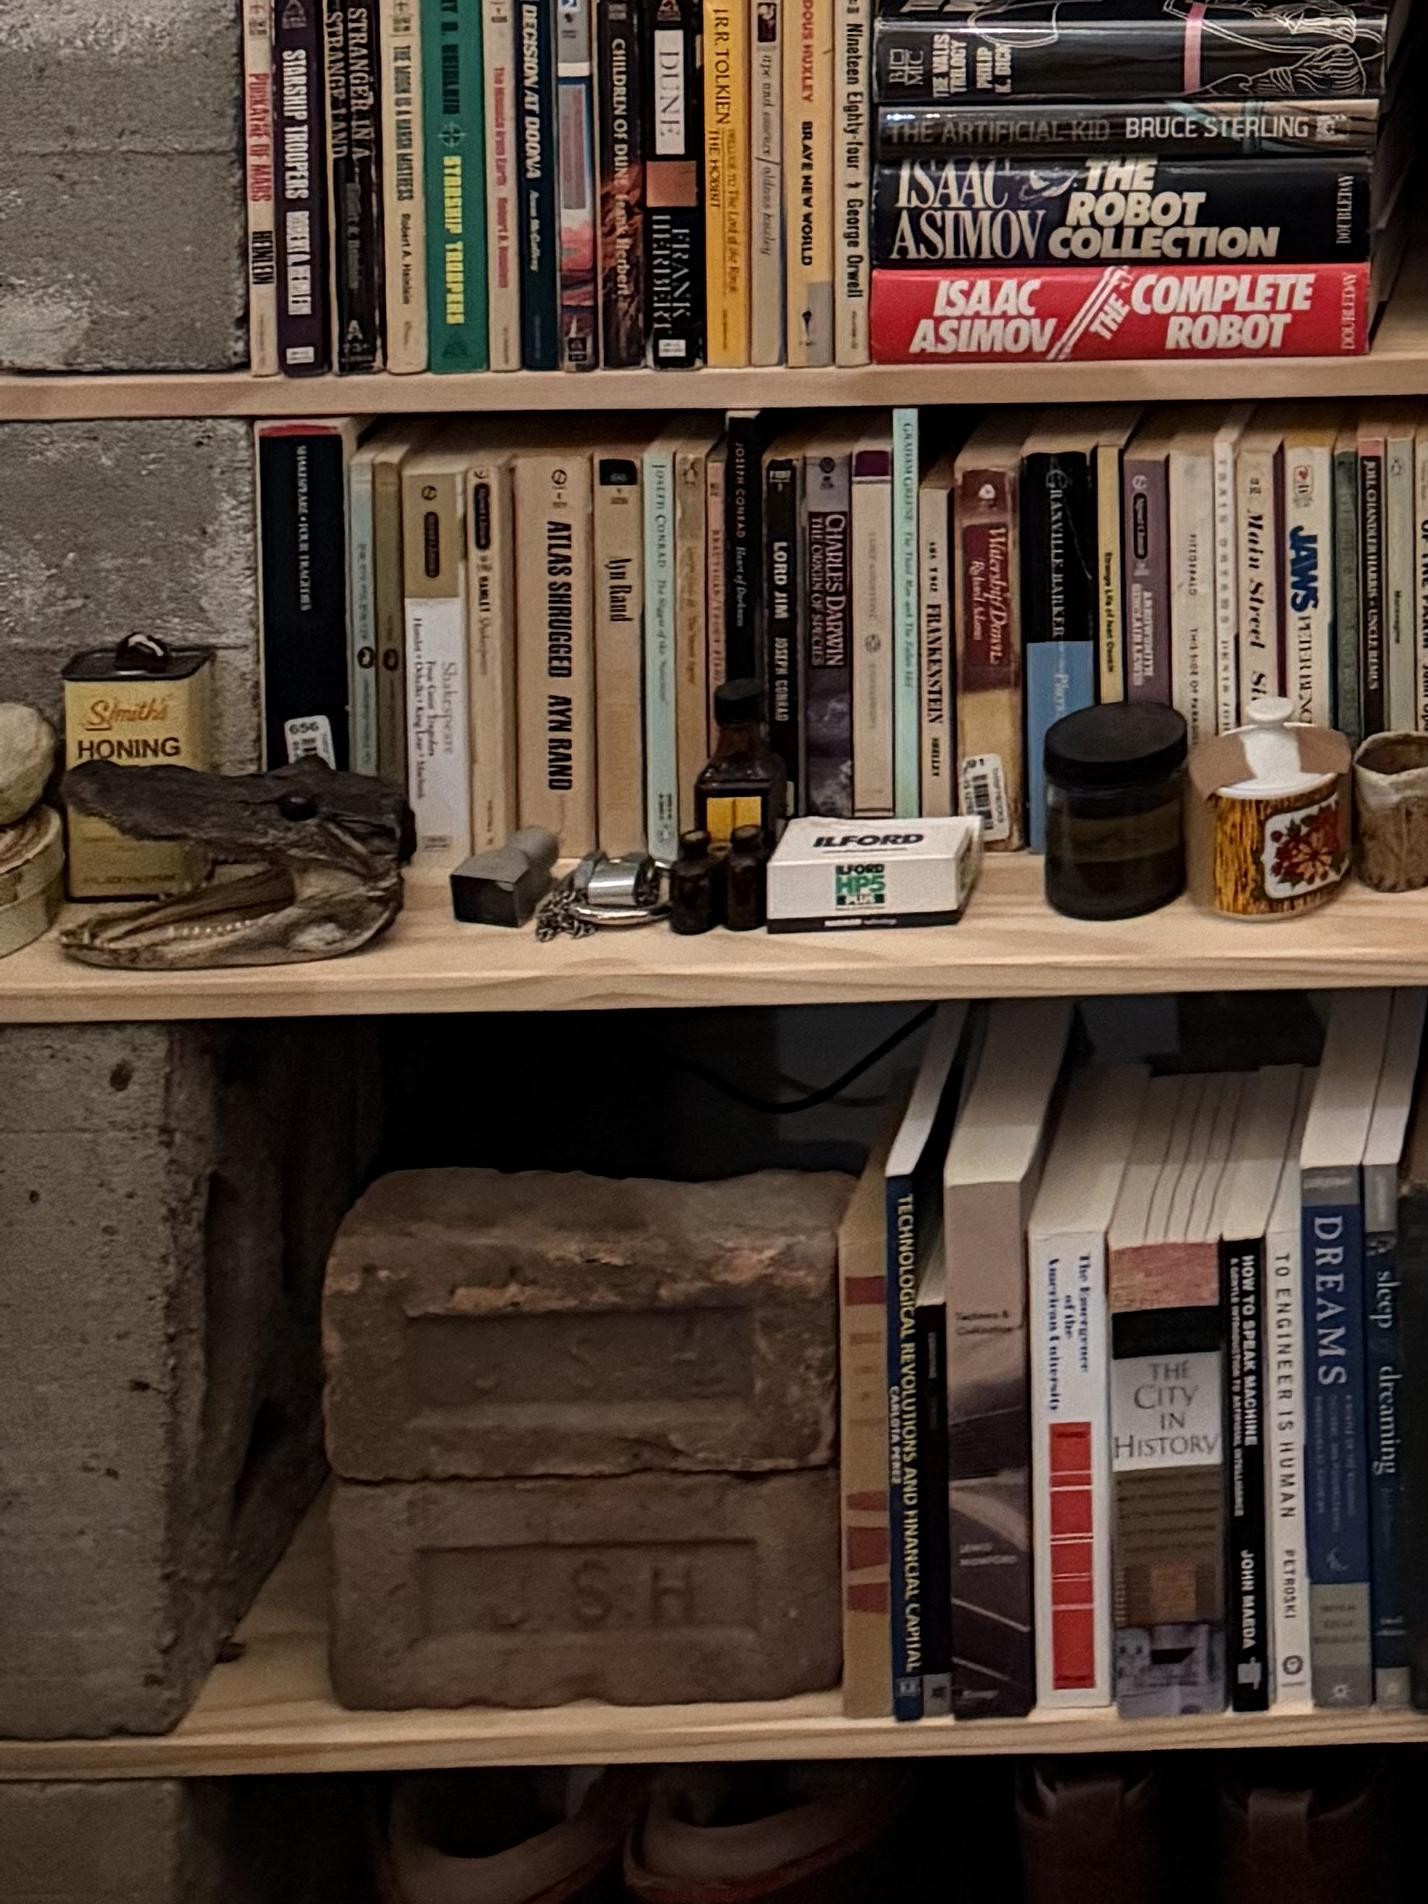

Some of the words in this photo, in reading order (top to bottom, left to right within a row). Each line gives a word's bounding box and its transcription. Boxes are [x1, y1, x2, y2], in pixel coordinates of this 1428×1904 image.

[659, 51, 681, 140] DUNE
[1126, 117, 1198, 138] BRUCE
[1204, 116, 1308, 137] STERLING
[895, 157, 1010, 207] ISAAC
[1086, 158, 1157, 190] THE
[1066, 193, 1205, 226] ROBOT
[890, 210, 1046, 259] ASIMOV
[1049, 227, 1279, 258] COLLECTION
[934, 280, 1042, 314] ISAAC
[1130, 274, 1313, 314] COMPLETE
[909, 319, 1057, 353] ASIMOV
[1165, 314, 1291, 349] ROBOT
[548, 521, 572, 574] ATLAS
[1290, 526, 1318, 611] JAWS
[548, 579, 572, 678] SHRUGGED
[548, 695, 571, 737] AYN
[78, 736, 180, 760] HONING
[548, 741, 572, 790] RAND
[813, 833, 923, 848] ILFORD
[836, 874, 886, 893] HP5
[1314, 1216, 1346, 1387] DREAMS
[1149, 1363, 1189, 1380] THE
[1135, 1385, 1199, 1410] CITY
[1160, 1411, 1186, 1431] IN
[1114, 1435, 1222, 1459] HISTORY
